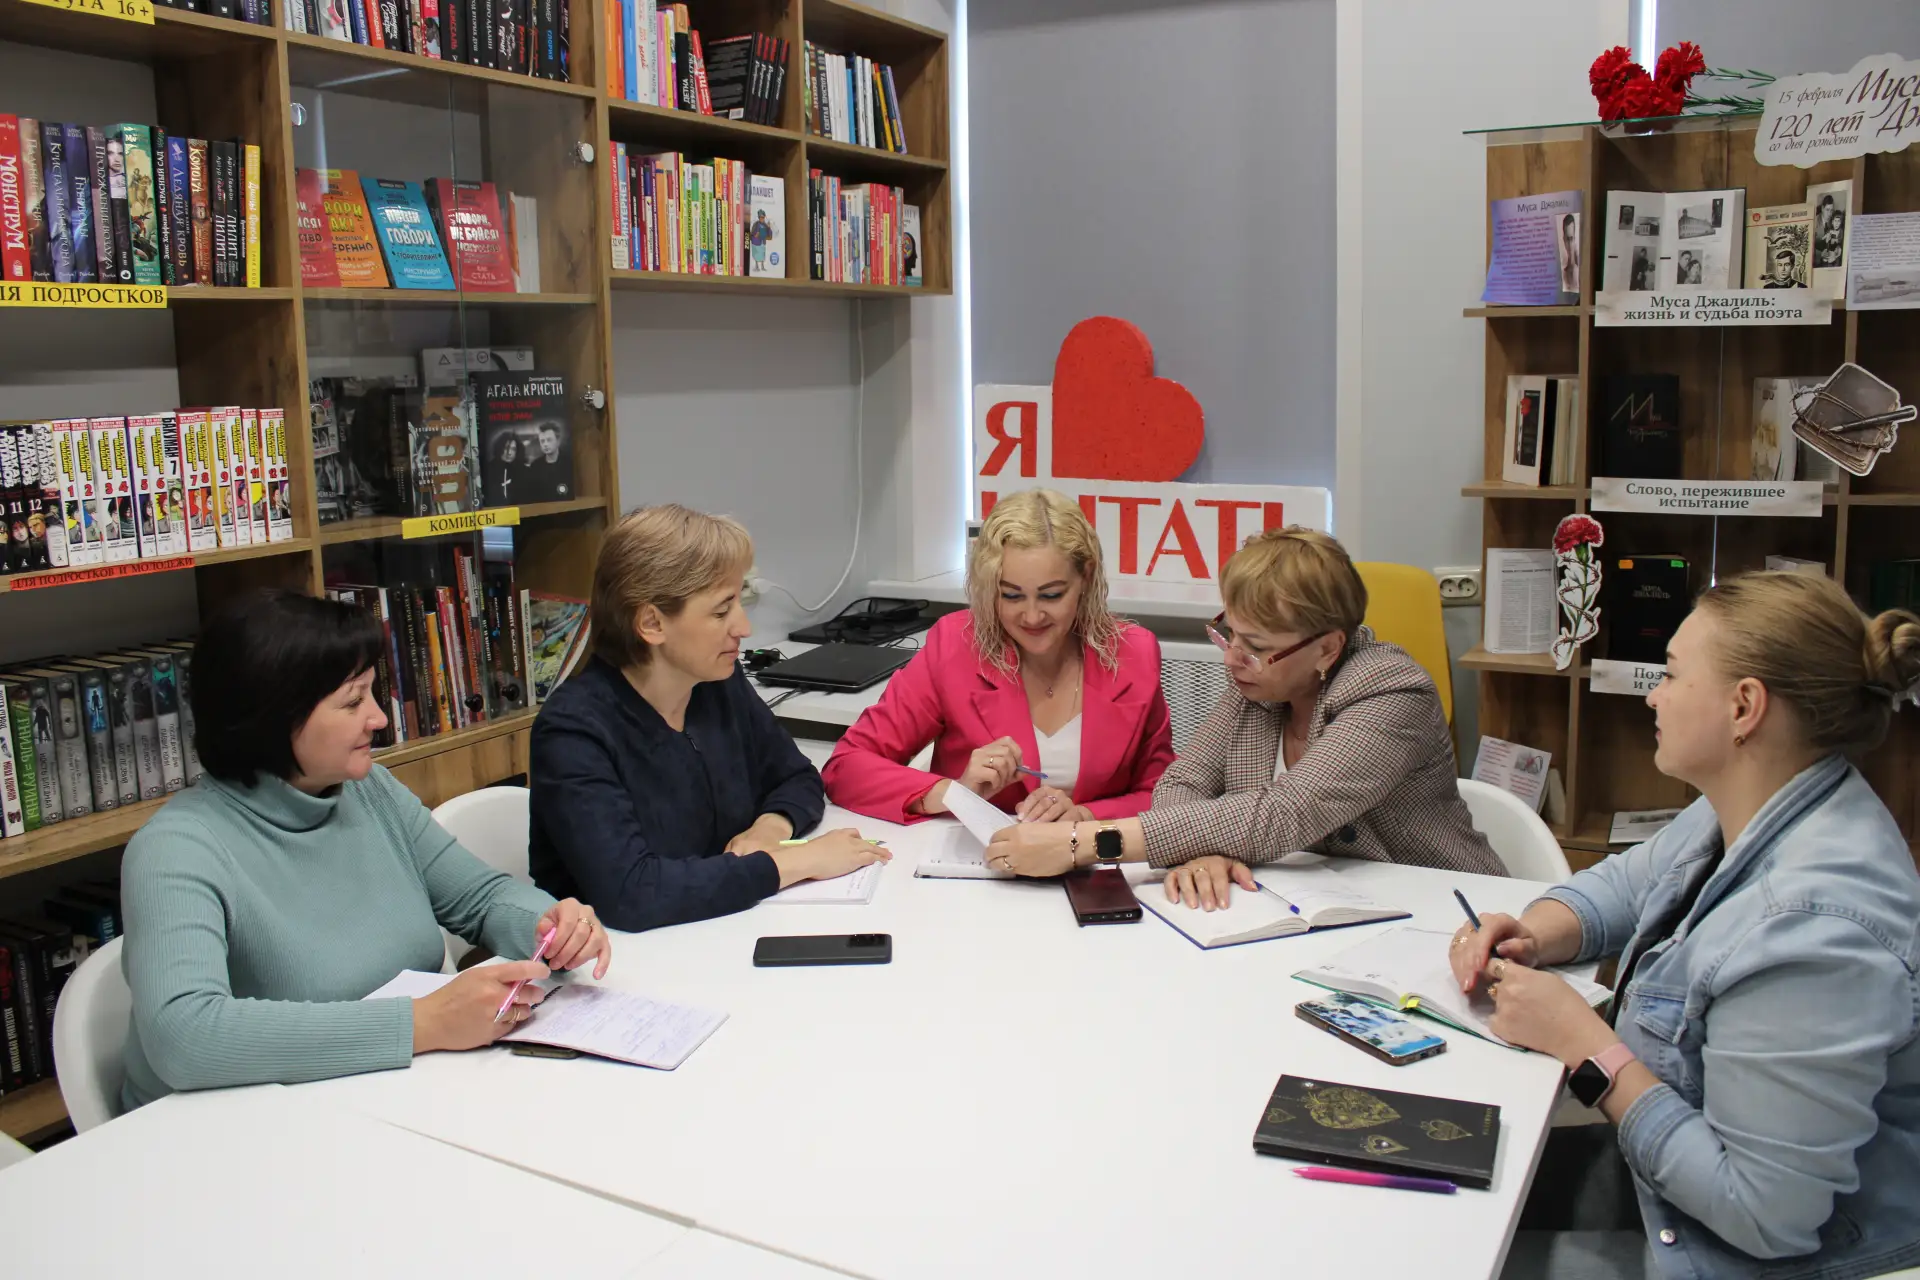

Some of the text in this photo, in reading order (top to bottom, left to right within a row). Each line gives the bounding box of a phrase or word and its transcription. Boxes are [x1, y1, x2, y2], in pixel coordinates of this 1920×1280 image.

[1778, 87, 1844, 107] 15 февраля
[1770, 113, 1813, 140] 120
[1819, 111, 1865, 135] лет
[1769, 134, 1858, 154] со дня рождения
[1517, 203, 1537, 213] Муса
[386, 227, 435, 247] ГОВОРИ
[32, 286, 164, 305] ПОДРОСТКОВ
[1649, 295, 1776, 311] Муса Джалиль:
[1624, 307, 1803, 322] жизнь и судьба поэта
[486, 382, 564, 399] АГАТА КРИСТИ
[979, 401, 1038, 478] Я
[170, 460, 177, 475] 7
[156, 477, 165, 489] 6
[190, 474, 198, 486] 7
[201, 472, 210, 484] 8
[220, 471, 229, 483] 9
[68, 485, 75, 497] 1
[84, 483, 93, 497] 2
[105, 482, 114, 495] 3
[119, 481, 129, 493] 4
[141, 479, 148, 491] 5
[1626, 482, 1786, 500] Слово, пережившее
[10, 501, 24, 515] 11
[28, 498, 42, 512] 12
[1659, 497, 1749, 509] испытание
[429, 512, 496, 533] КОМИКСЫ
[39, 567, 114, 587] ПОДРОСТКОВ
[132, 557, 193, 573] МОЛОДЕЖИ
[1633, 667, 1663, 680] Поэ
[1633, 681, 1644, 690] и
